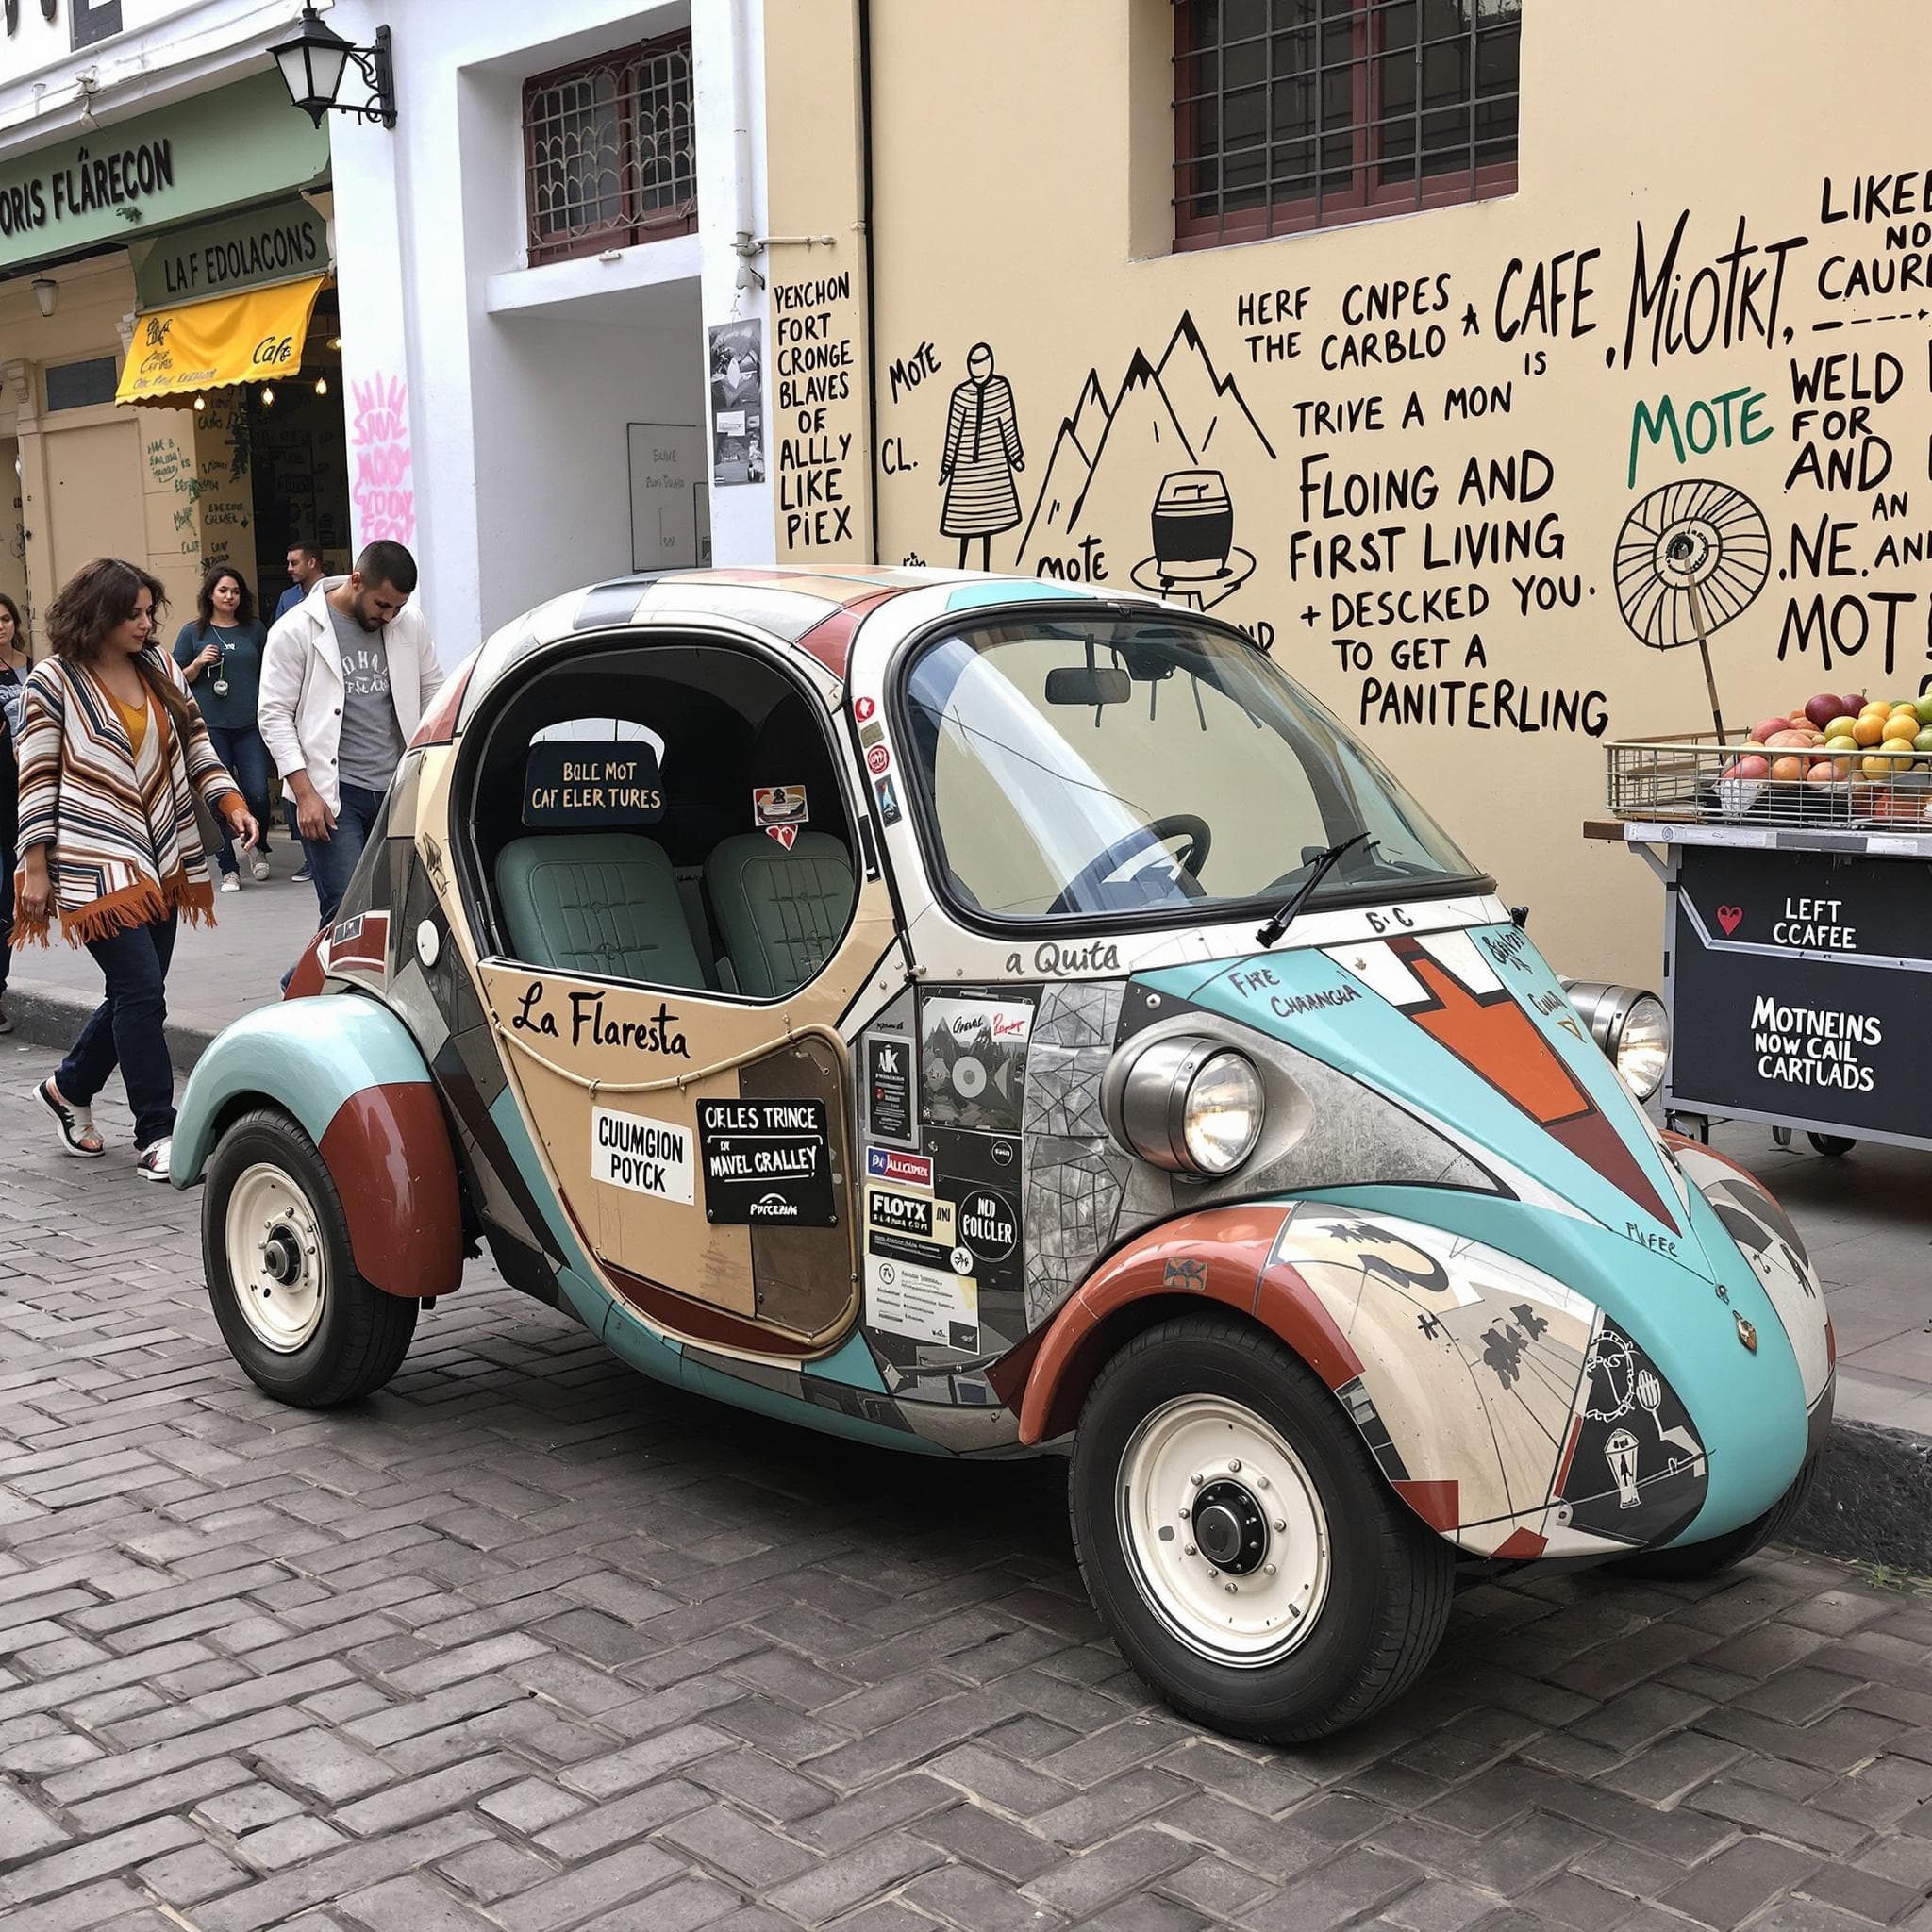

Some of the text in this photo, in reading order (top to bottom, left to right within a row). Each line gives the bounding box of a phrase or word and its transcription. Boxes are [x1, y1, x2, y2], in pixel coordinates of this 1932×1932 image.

[205, 222, 317, 284] EDOLACONS
[1238, 286, 1311, 326] HERF
[1342, 273, 1451, 325] CNPES
[1495, 248, 1601, 342] CAFE
[1818, 253, 1932, 300] CAUR
[778, 313, 831, 345] FORT
[1245, 331, 1302, 363] THE
[1320, 325, 1446, 371] CARBLO
[778, 340, 854, 376] CRONGE
[890, 341, 941, 404] MOTE
[1524, 350, 1547, 375] IS
[1790, 352, 1904, 404] WELD
[780, 372, 848, 408] BLAVES
[1292, 381, 1512, 438] TRIVE A MON
[1628, 386, 1774, 490] MOTE
[1792, 406, 1873, 441] FOR
[780, 433, 852, 470] ALLLY
[882, 437, 918, 475] CL.
[1784, 436, 1892, 492] AND
[781, 468, 842, 510] LIKE
[1299, 449, 1554, 522] FLOING AND
[1872, 492, 1907, 521] AN
[1290, 513, 1565, 581] FIRST LIVING
[1332, 583, 1490, 631] DESCKED
[1332, 634, 1487, 672] TO GET A
[1360, 676, 1609, 738] PANITERLING
[605, 761, 637, 781] MOT
[608, 788, 661, 809] TURES
[1785, 897, 1842, 923] LEFT
[1773, 922, 1857, 949] CCAFEE
[1034, 941, 1121, 976] Quita
[513, 981, 691, 1059] La Flaresta
[1751, 995, 1882, 1046] MOTNEINS
[1755, 1033, 1857, 1063] NOW CAIL
[763, 1107, 818, 1130] TRINCE
[598, 1116, 684, 1164] CUUMGION
[610, 1152, 666, 1193] POYCK
[710, 1155, 753, 1177] MAVEL
[754, 1145, 817, 1173] CRALLEY
